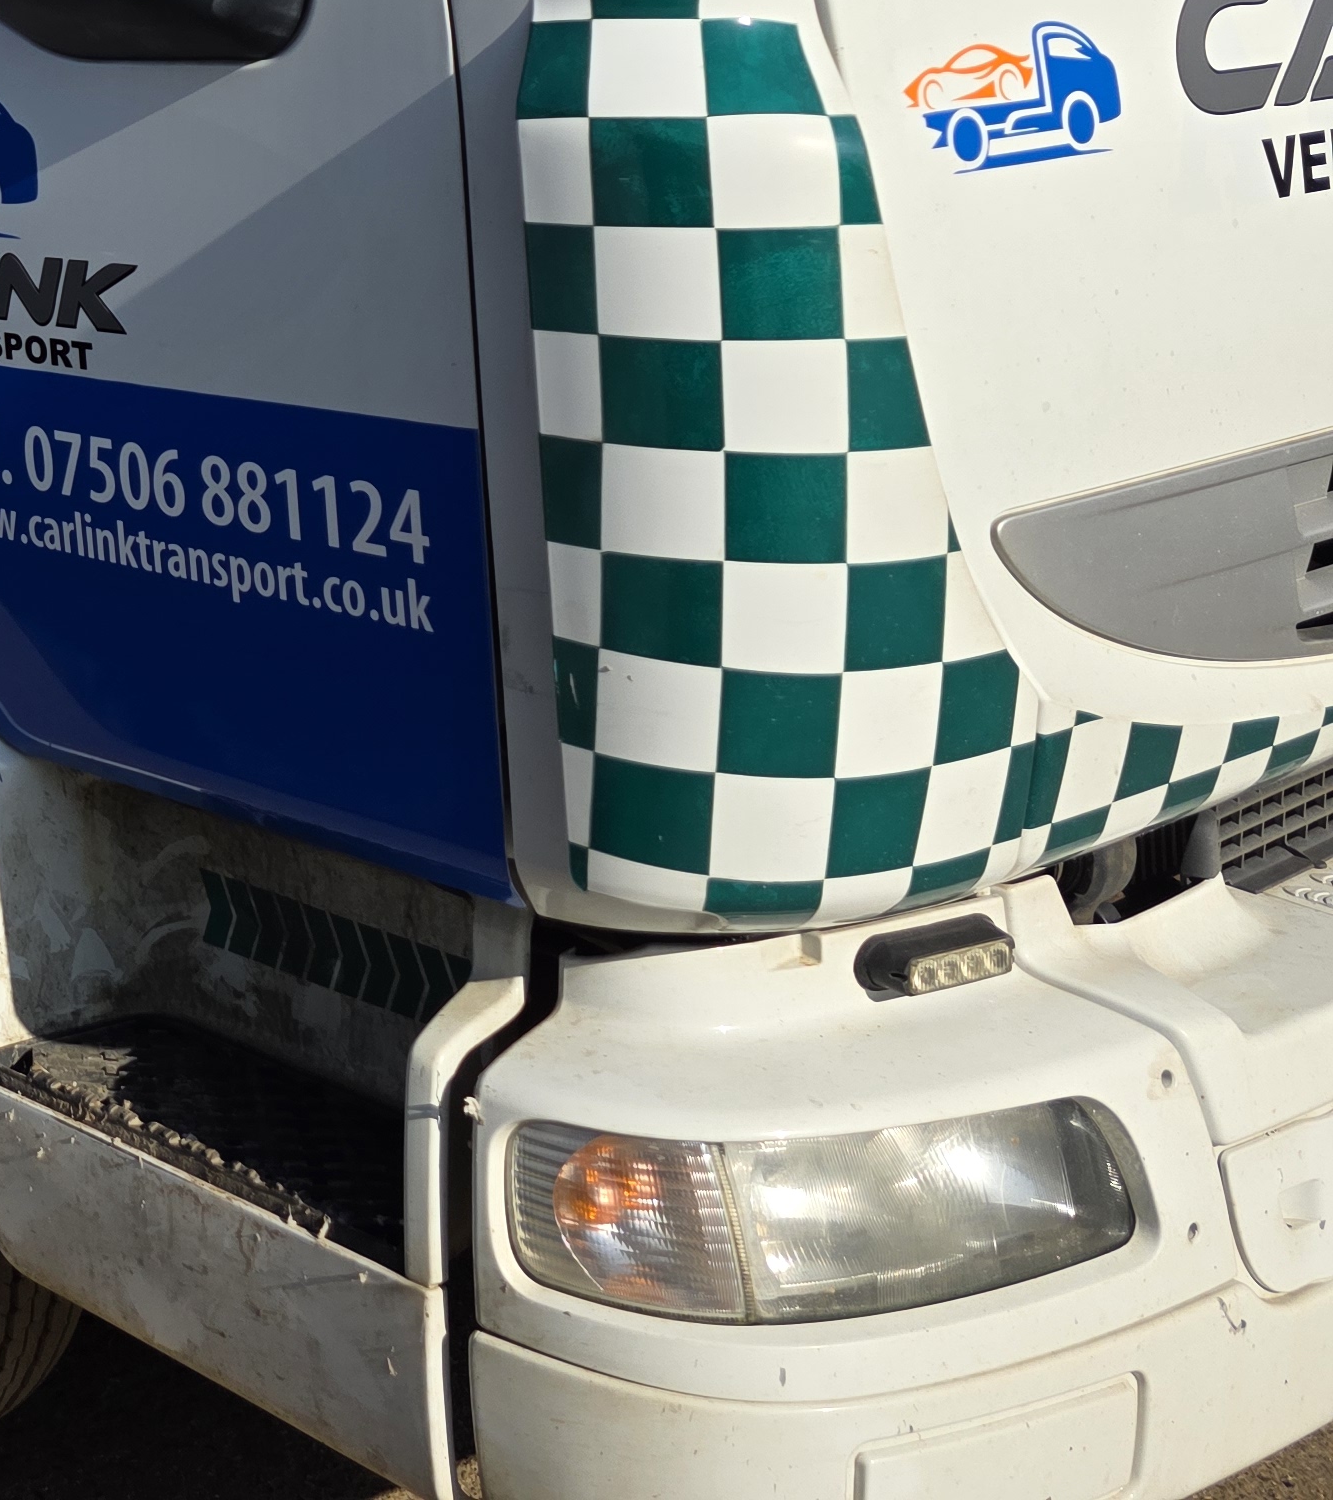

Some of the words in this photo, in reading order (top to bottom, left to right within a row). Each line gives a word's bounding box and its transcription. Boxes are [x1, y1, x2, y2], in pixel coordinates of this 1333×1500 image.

[1261, 128, 1333, 199] VE
[24, 425, 186, 517] 07506
[200, 454, 430, 565] 881124
